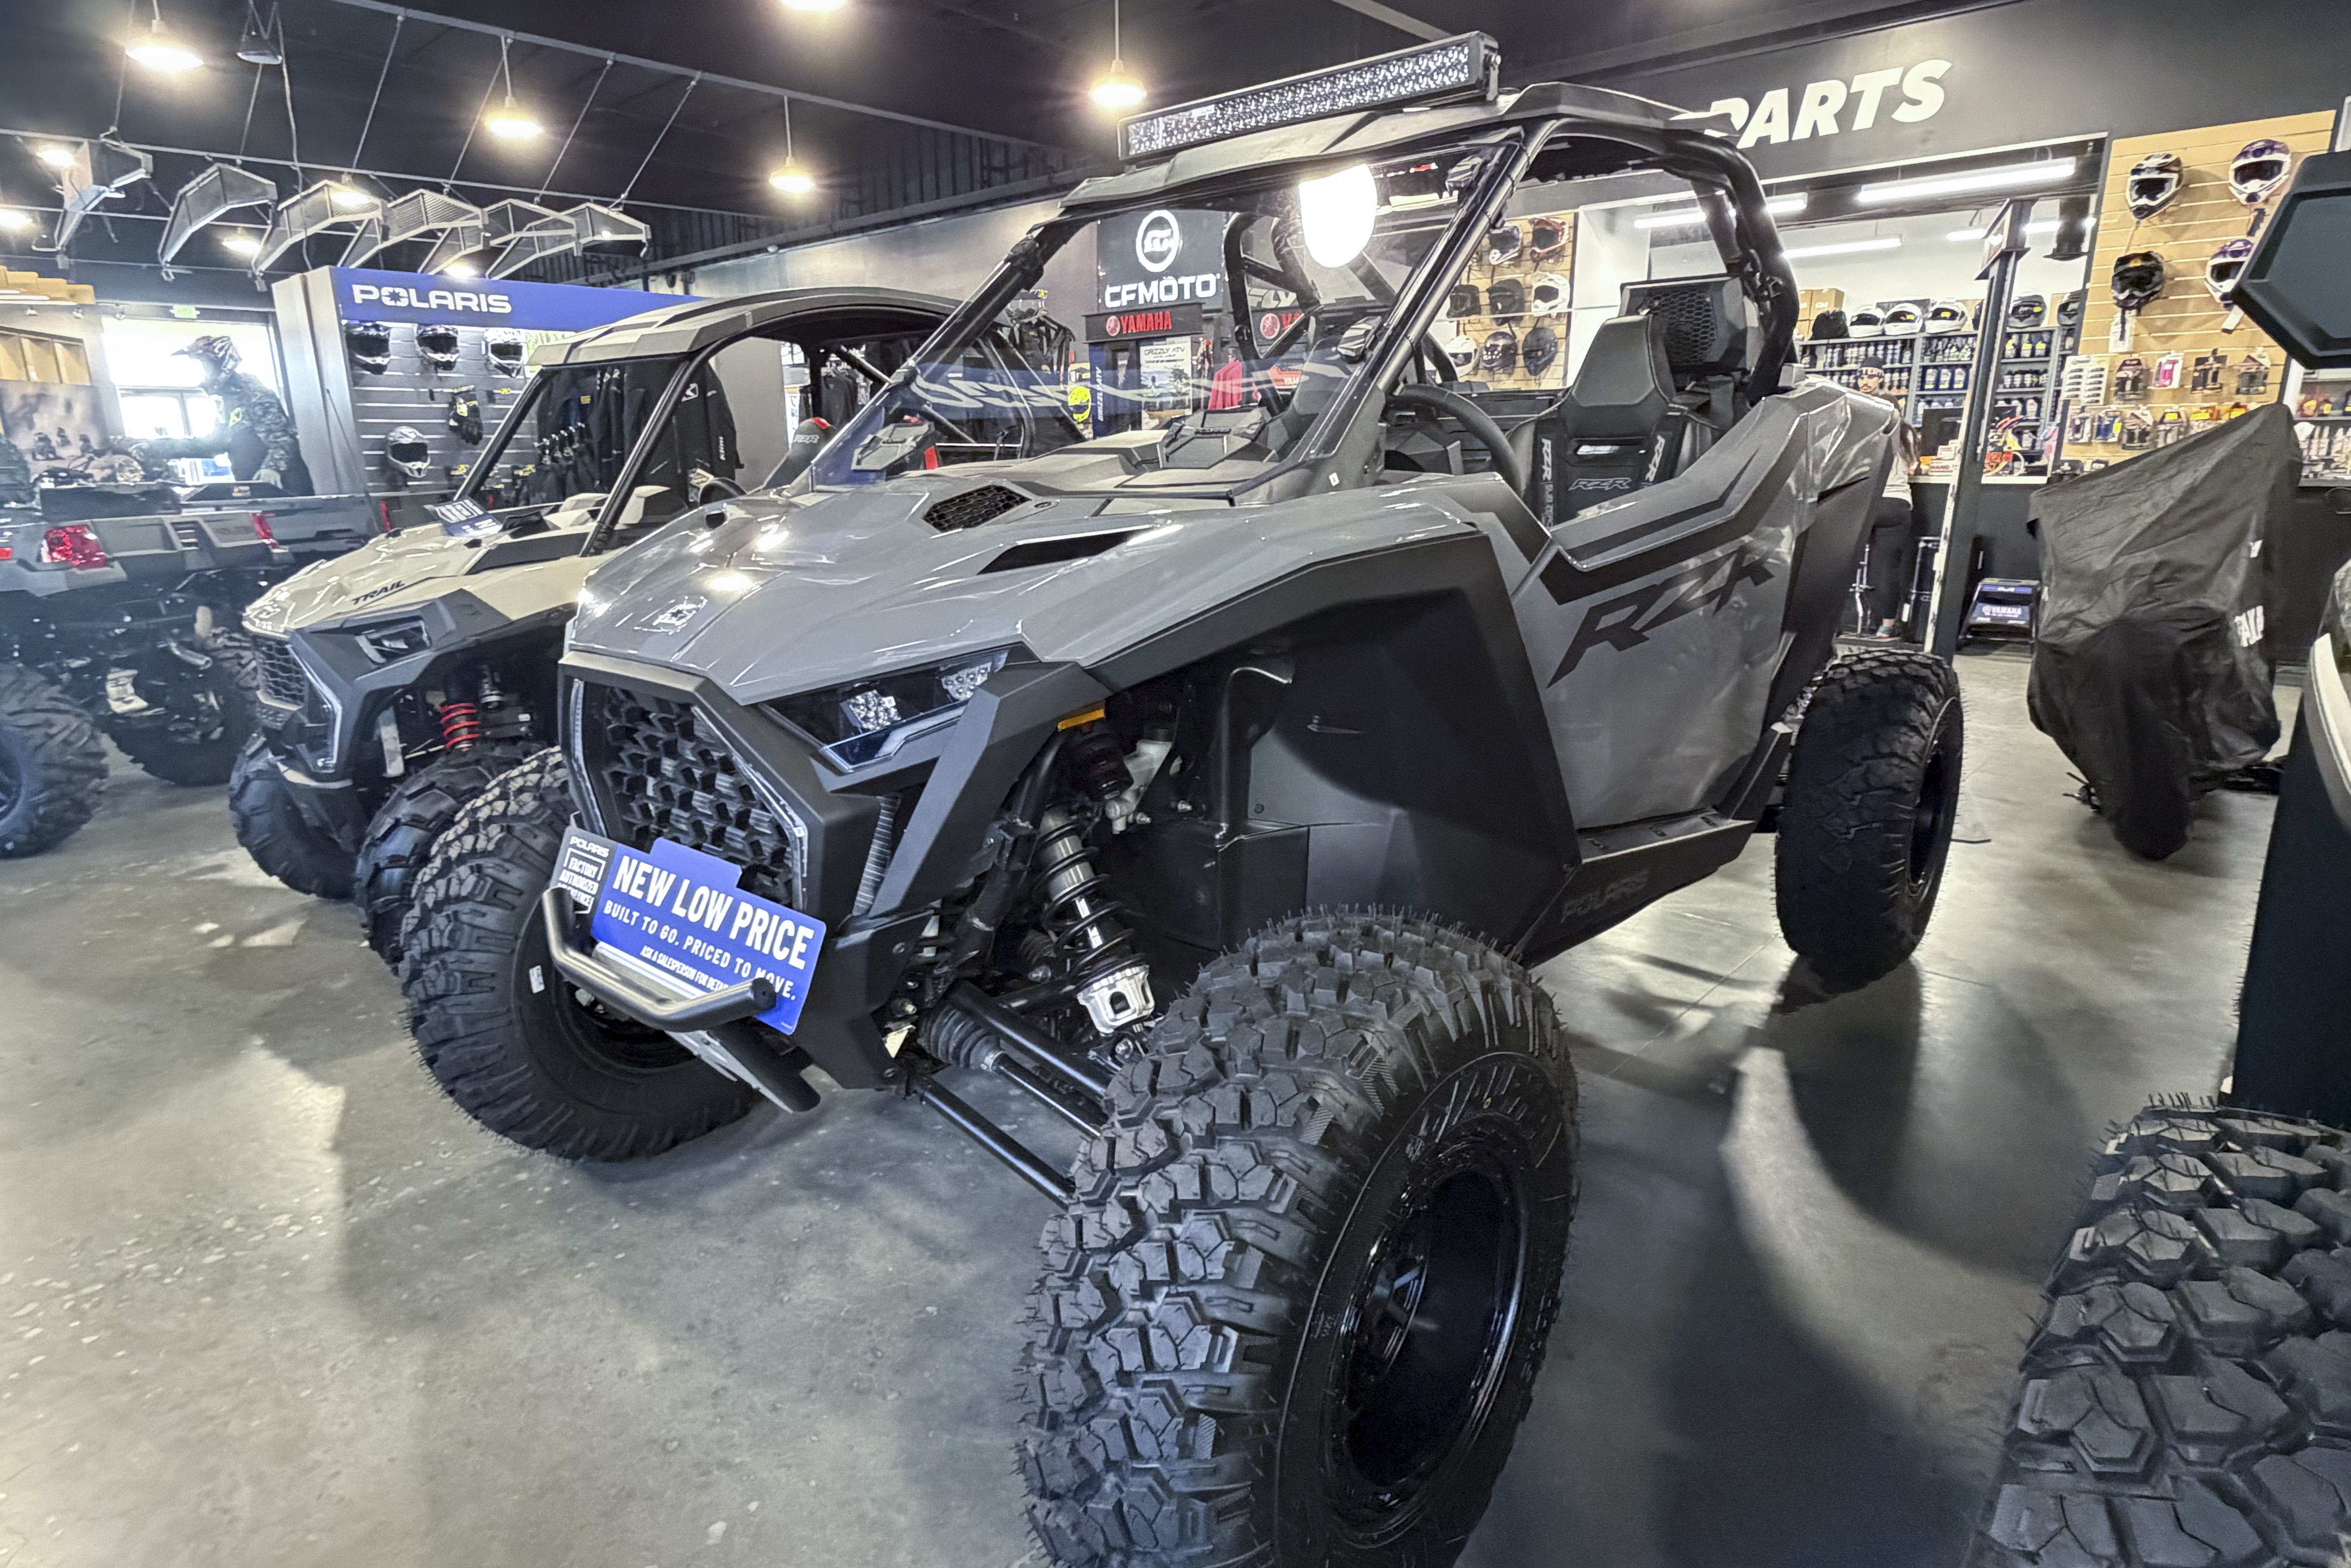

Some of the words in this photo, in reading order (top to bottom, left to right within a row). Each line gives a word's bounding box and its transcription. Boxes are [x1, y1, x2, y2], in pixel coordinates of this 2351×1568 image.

[1704, 59, 1952, 149] PARTS
[352, 284, 512, 313] POLARIS
[1105, 274, 1216, 308] CFMOTO
[1120, 310, 1171, 334] YAMAHA
[1541, 438, 1552, 481] RZR
[1645, 435, 1665, 482] RZR
[1568, 477, 1632, 491] RZR
[351, 580, 405, 605] TRAIL
[1546, 545, 1775, 689] RZR
[1992, 606, 2022, 615] YAMAHA
[570, 836, 610, 857] POLARIS
[568, 857, 598, 878] FACTORY
[613, 856, 676, 907] NEW
[672, 879, 733, 932] LOW
[729, 902, 814, 970] PRICE
[603, 900, 639, 926] BUILT
[642, 916, 658, 935] TO
[660, 925, 679, 946] GO.
[683, 935, 731, 968] PRICED
[736, 958, 751, 978] TO
[640, 945, 655, 959] ASK
[651, 951, 658, 961] A
[656, 953, 697, 980] SALESPERSON
[694, 971, 709, 986] FOR
